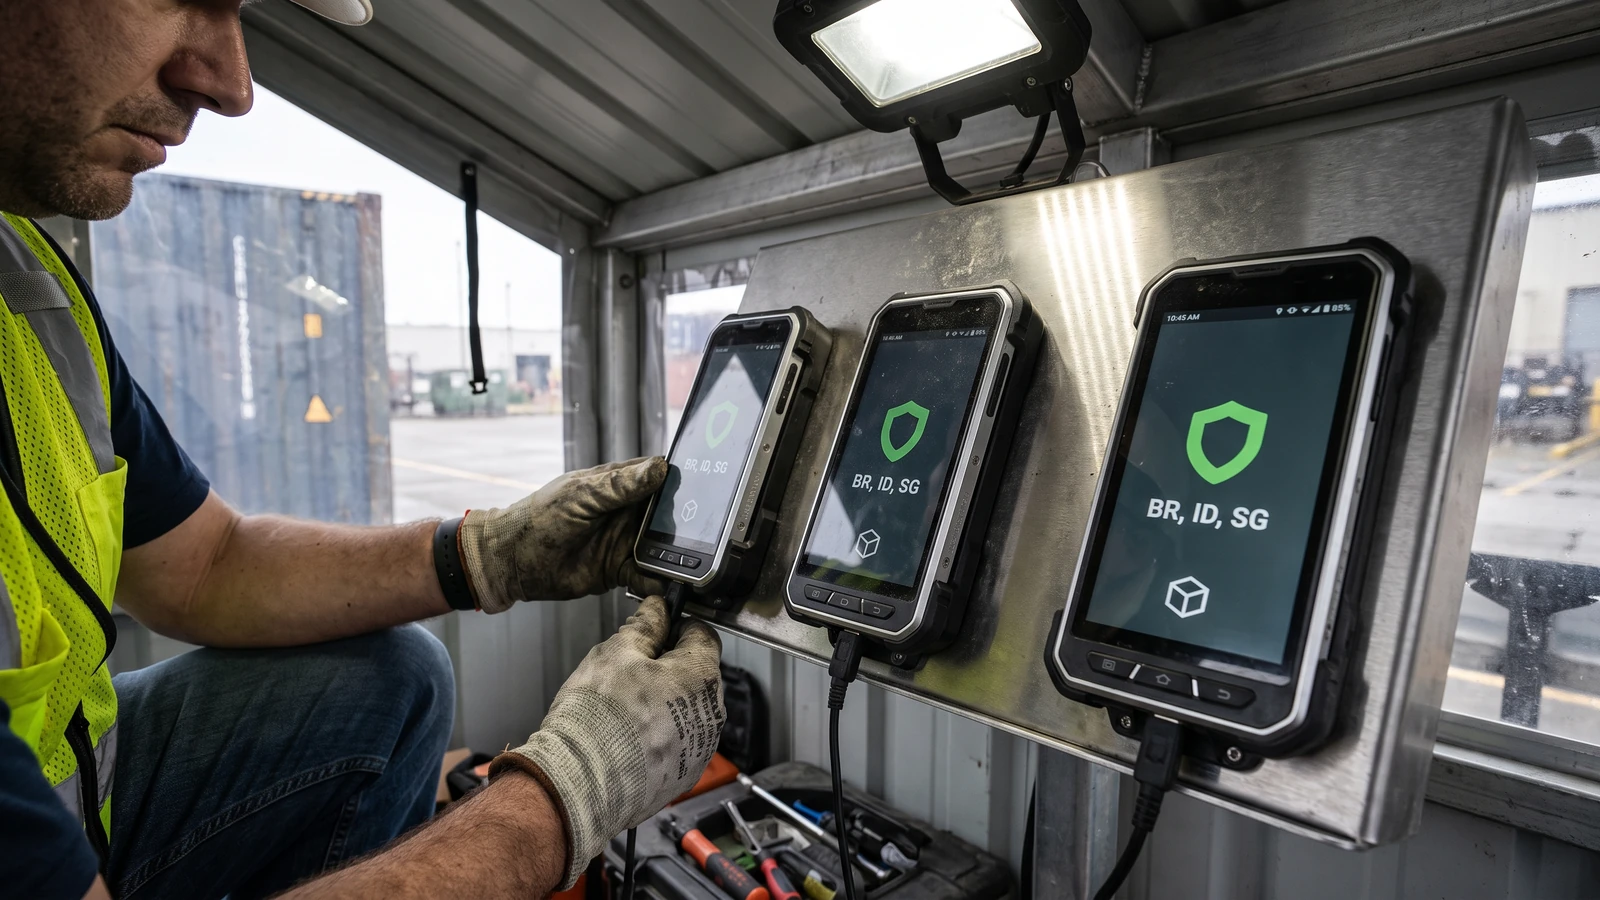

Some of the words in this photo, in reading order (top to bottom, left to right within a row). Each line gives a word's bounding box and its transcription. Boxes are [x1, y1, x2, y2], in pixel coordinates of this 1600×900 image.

[1331, 303, 1352, 312] 85%
[1167, 313, 1187, 322] 10:45
[1187, 313, 1201, 321] AM
[683, 458, 698, 473] BR,
[700, 459, 711, 475] ID,
[713, 460, 729, 474] SG
[851, 473, 873, 493] BR,
[877, 475, 895, 495] ID,
[898, 478, 921, 495] SG
[1146, 498, 1184, 526] BR,
[1192, 502, 1223, 530] ID,
[1230, 506, 1270, 531] SG
